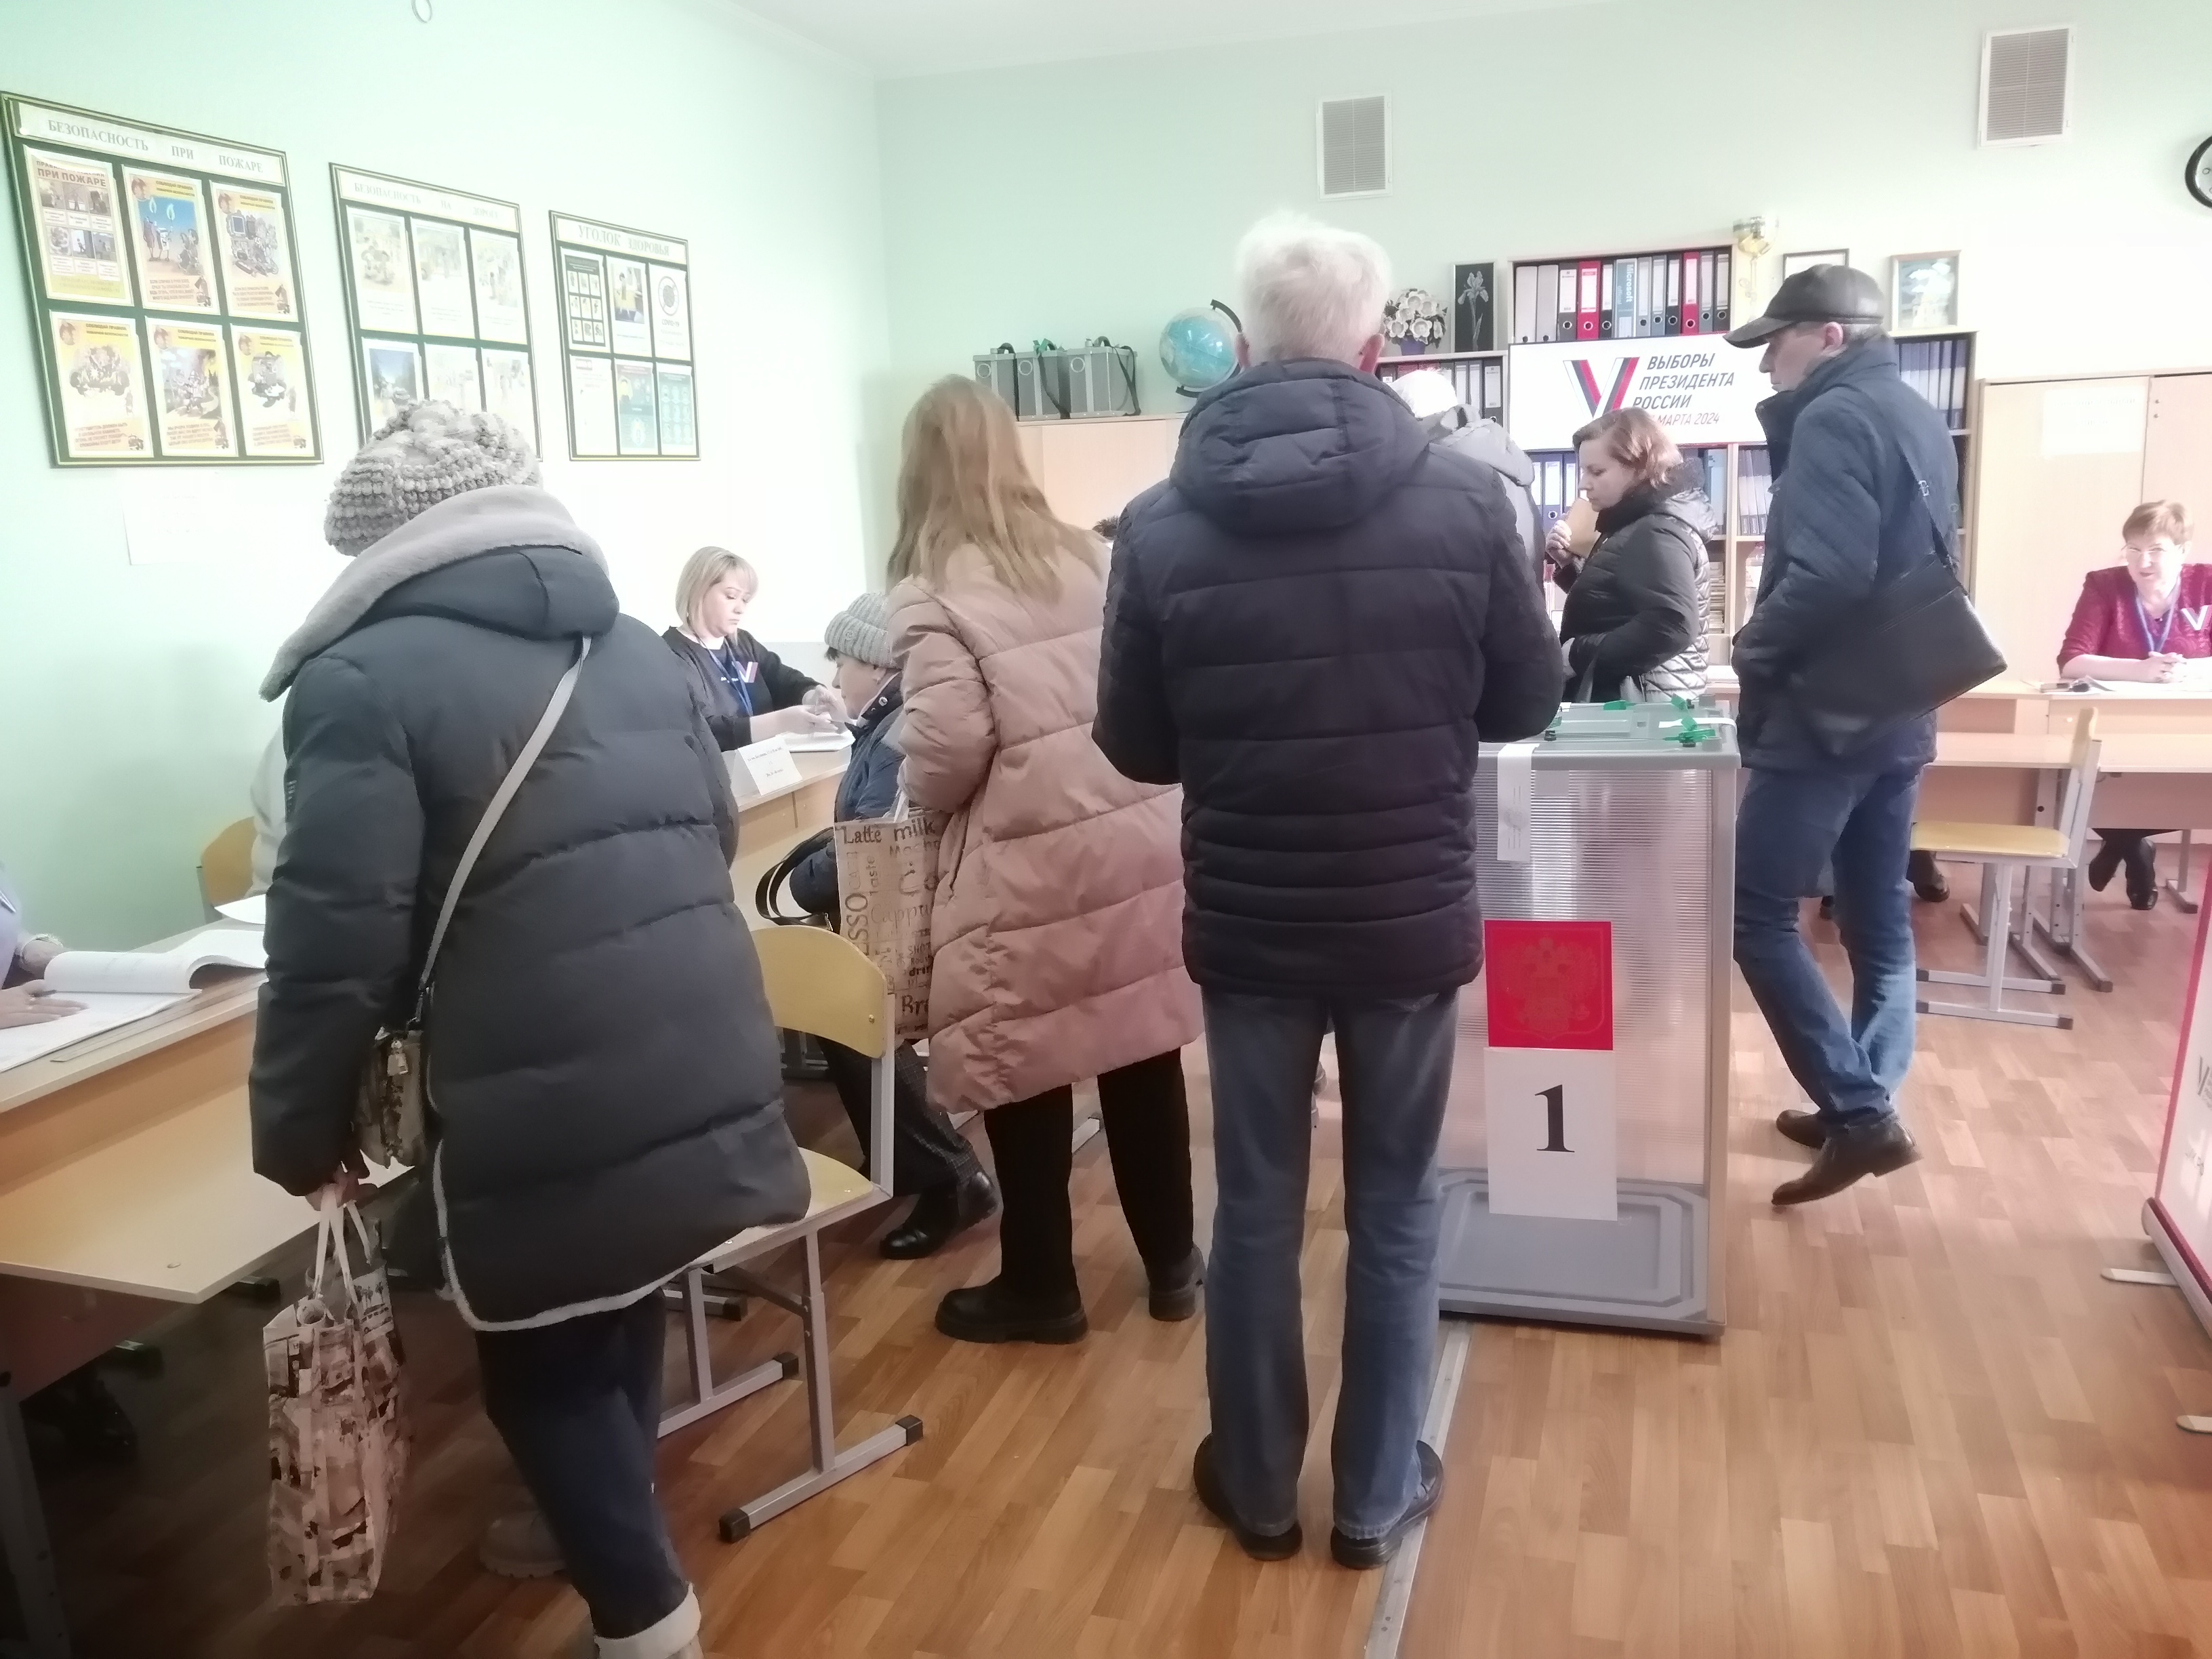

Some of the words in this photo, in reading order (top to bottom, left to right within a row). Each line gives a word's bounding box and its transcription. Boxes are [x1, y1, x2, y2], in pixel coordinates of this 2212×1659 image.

[47, 119, 149, 152] БЕЗОПАСНОСТЬ
[171, 144, 194, 159] ПРИ
[218, 154, 264, 173] ПОЖАРЕ
[37, 168, 59, 180] ПРИ
[62, 172, 106, 187] ПОЖАРЕ
[354, 182, 422, 205] БЕЗОПАСНОСТЬ
[441, 199, 452, 210] НА
[472, 206, 499, 220] ДОРОГЕ
[578, 224, 621, 247] УГОЛОК
[628, 237, 670, 257] ЗДОРОВЬЯ
[1626, 264, 1635, 303] Microsoft
[1647, 352, 1716, 370] ВЫБОРЫ
[1639, 371, 1735, 390] ПРЕЗИДЕНТА
[1633, 394, 1693, 410] РОССИИ
[1658, 413, 1692, 426] МАРТА
[1694, 412, 1720, 425] 2024
[843, 825, 882, 844] Latte
[893, 817, 936, 842] milk
[1534, 1084, 1576, 1153] 1
